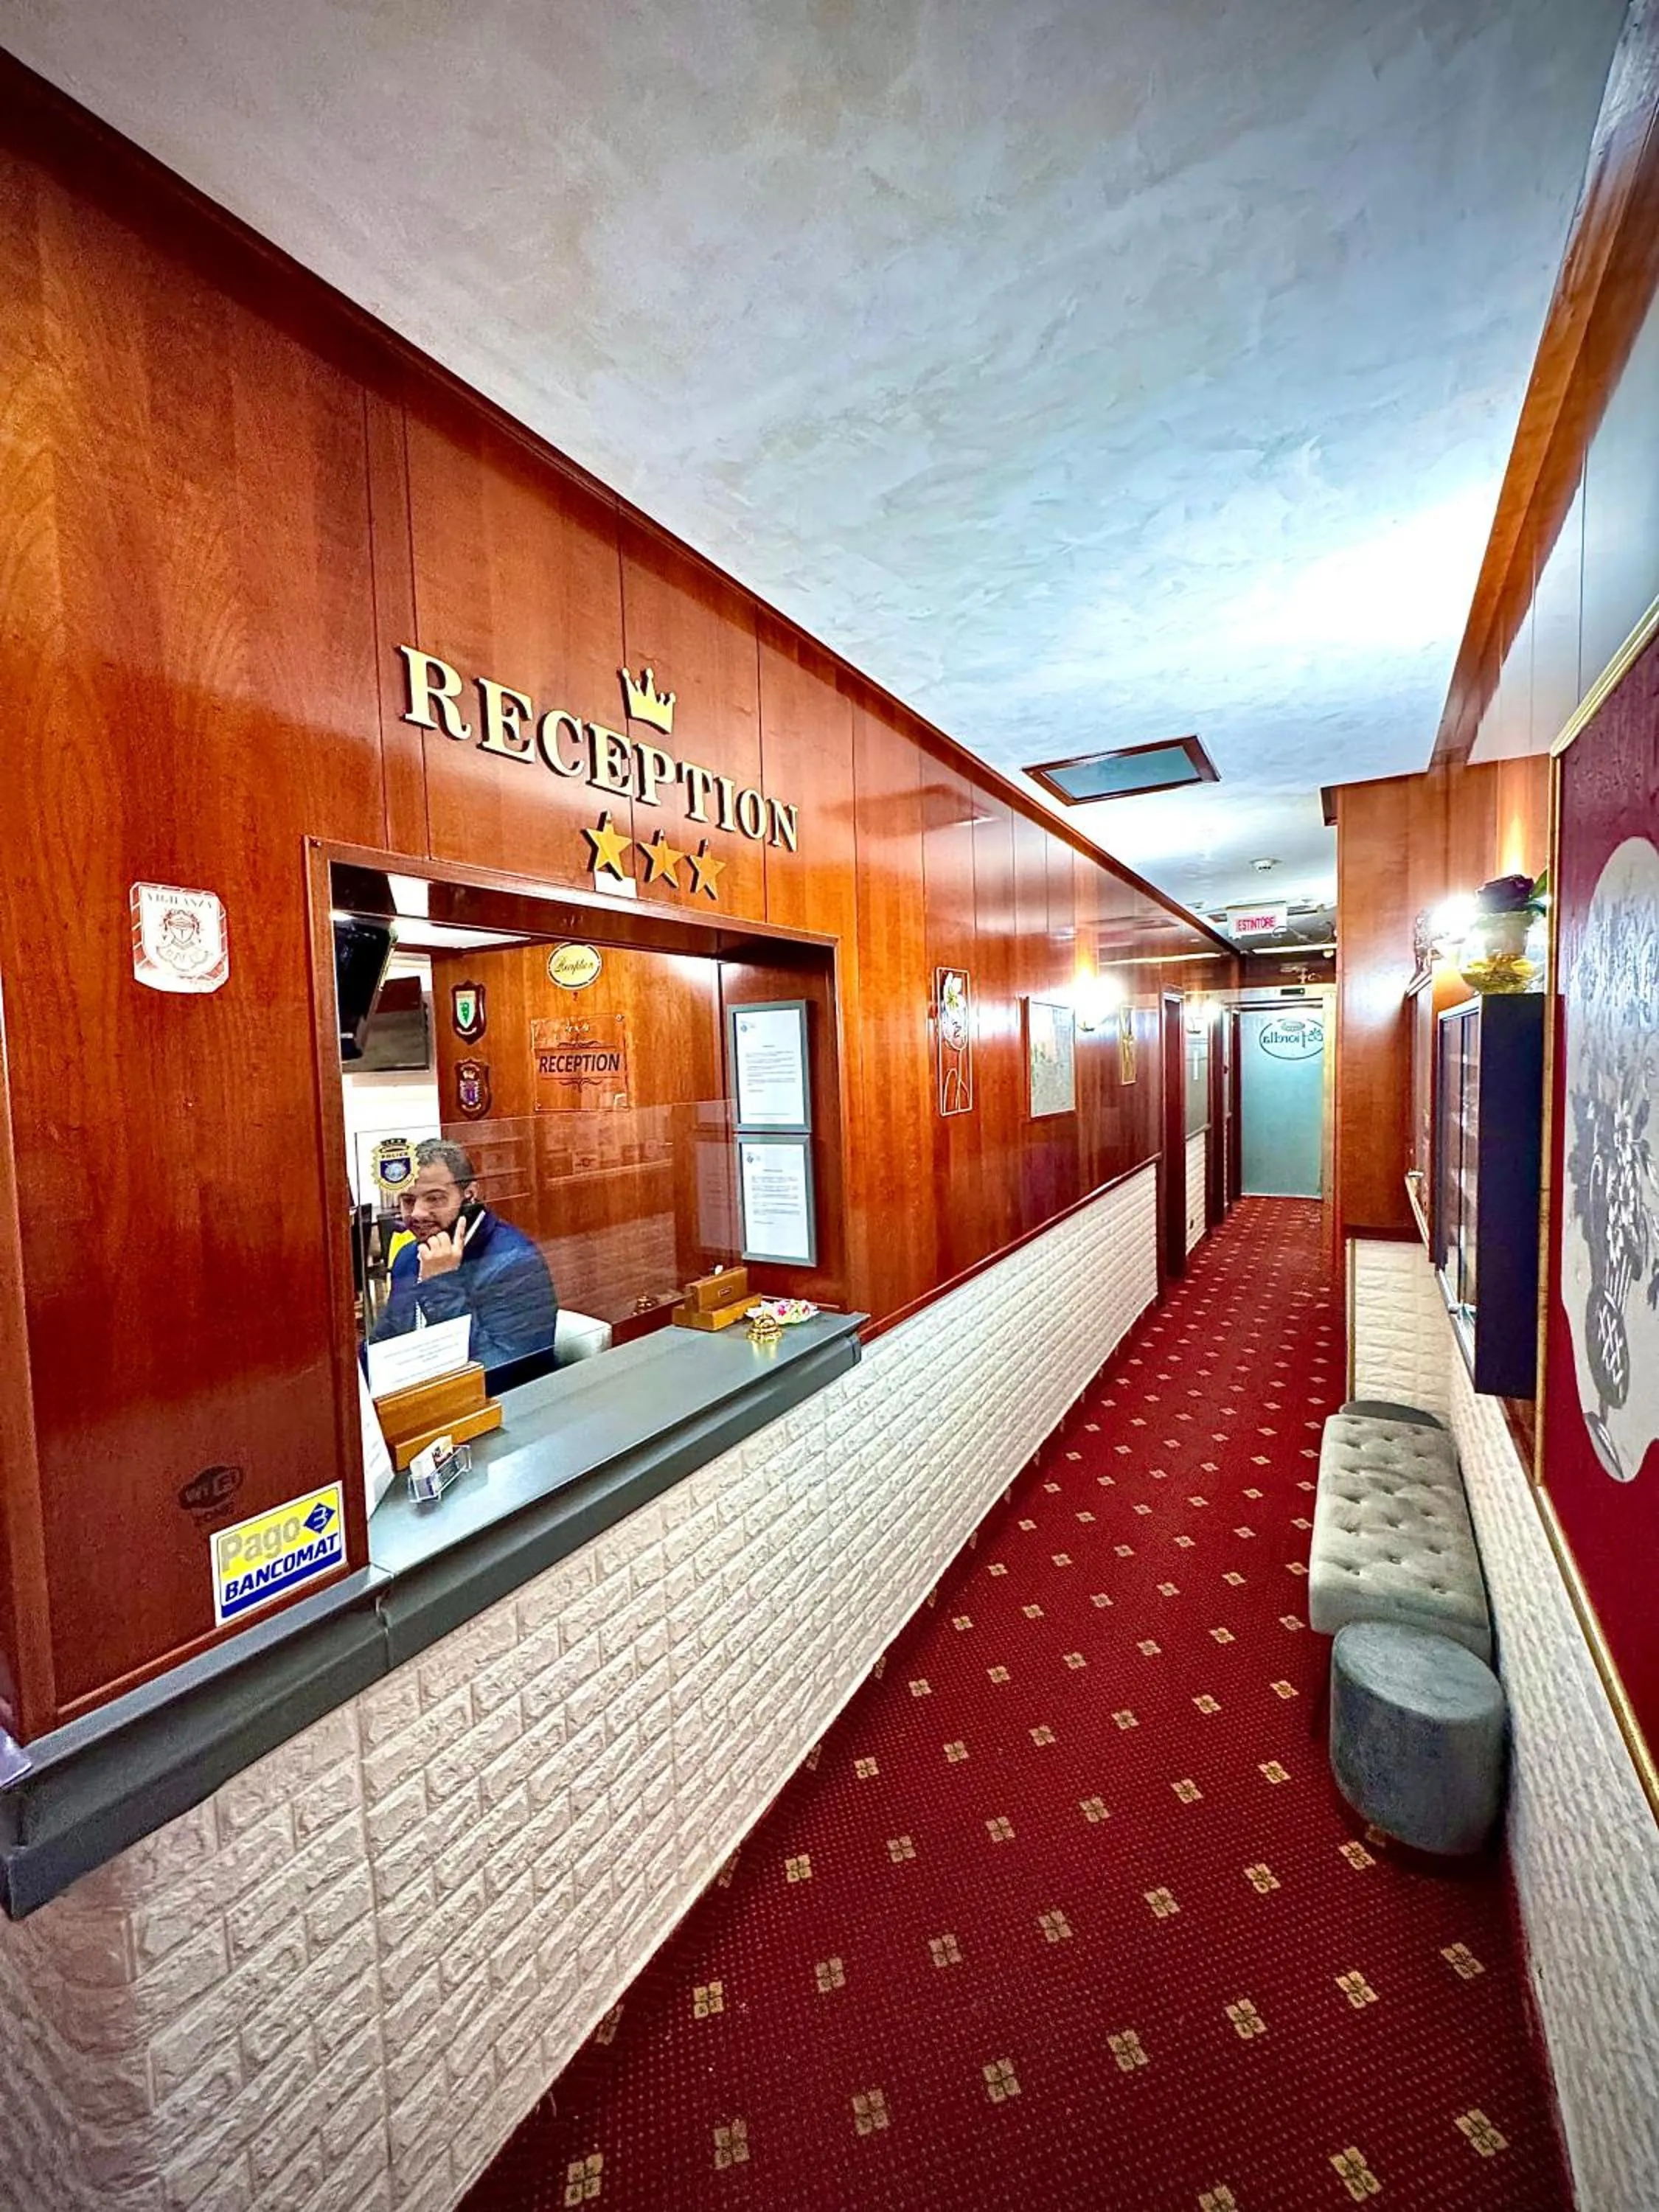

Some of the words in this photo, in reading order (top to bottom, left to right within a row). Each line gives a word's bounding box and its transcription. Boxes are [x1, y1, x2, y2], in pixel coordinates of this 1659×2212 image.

[397, 644, 799, 852] RECEPTION
[1237, 916, 1275, 932] ESTINTORE
[539, 1054, 620, 1073] RECEPTION
[220, 1517, 301, 1572] Pago
[225, 1533, 338, 1602] BANCOMAT
